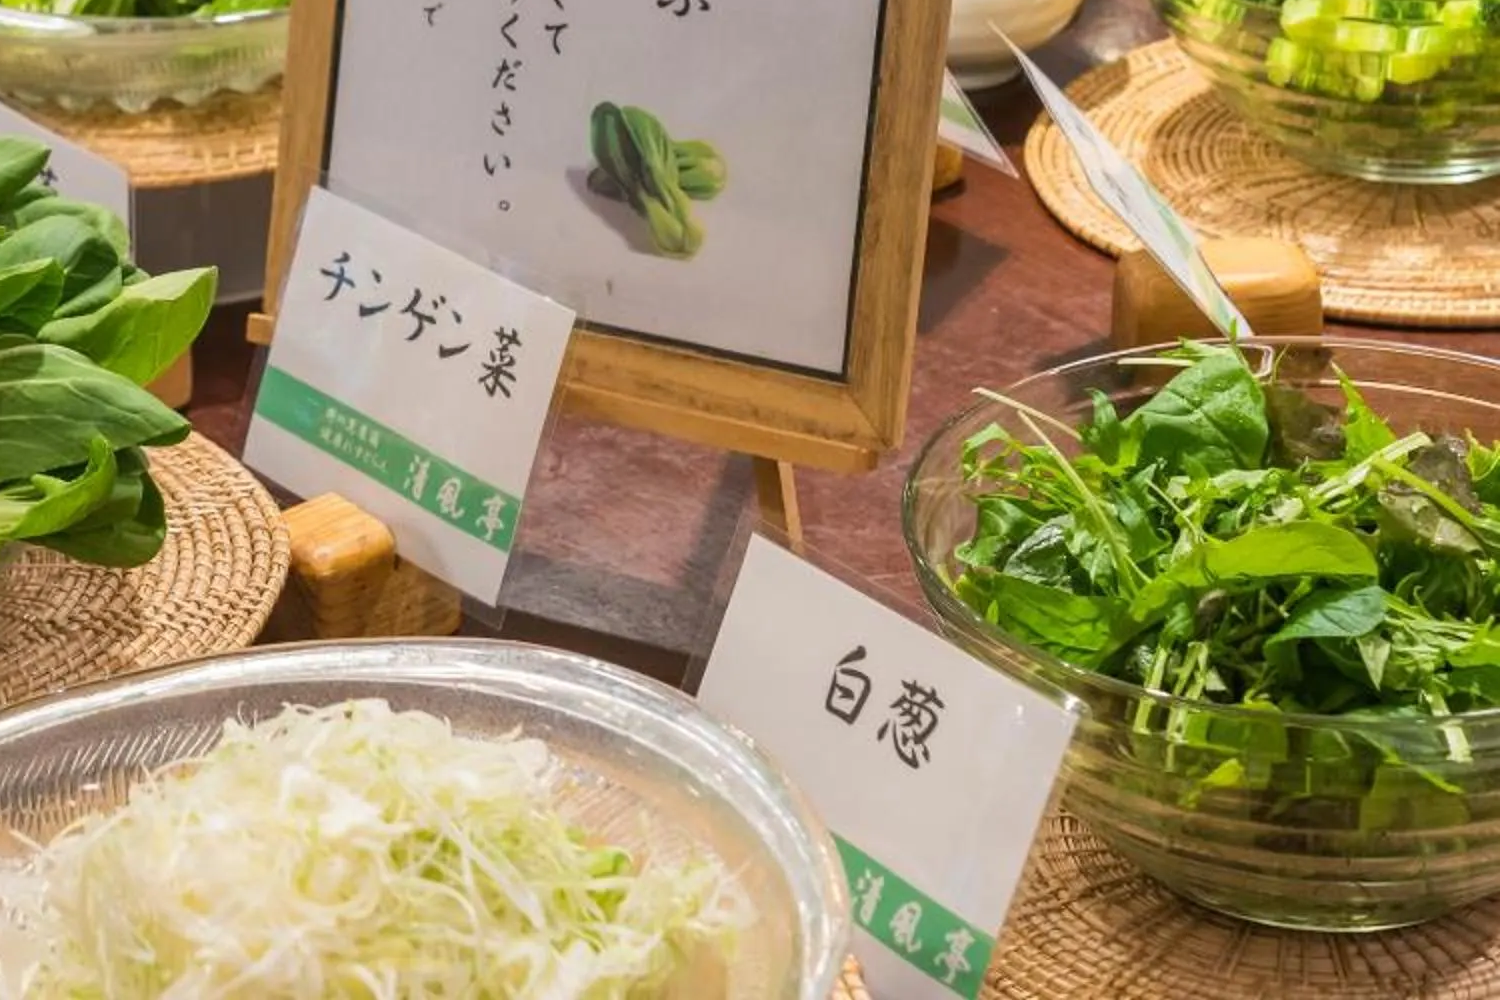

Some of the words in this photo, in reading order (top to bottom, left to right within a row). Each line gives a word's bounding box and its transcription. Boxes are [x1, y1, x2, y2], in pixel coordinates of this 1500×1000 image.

[320, 251, 524, 400] チンゲン菜
[824, 644, 946, 770] 白葱
